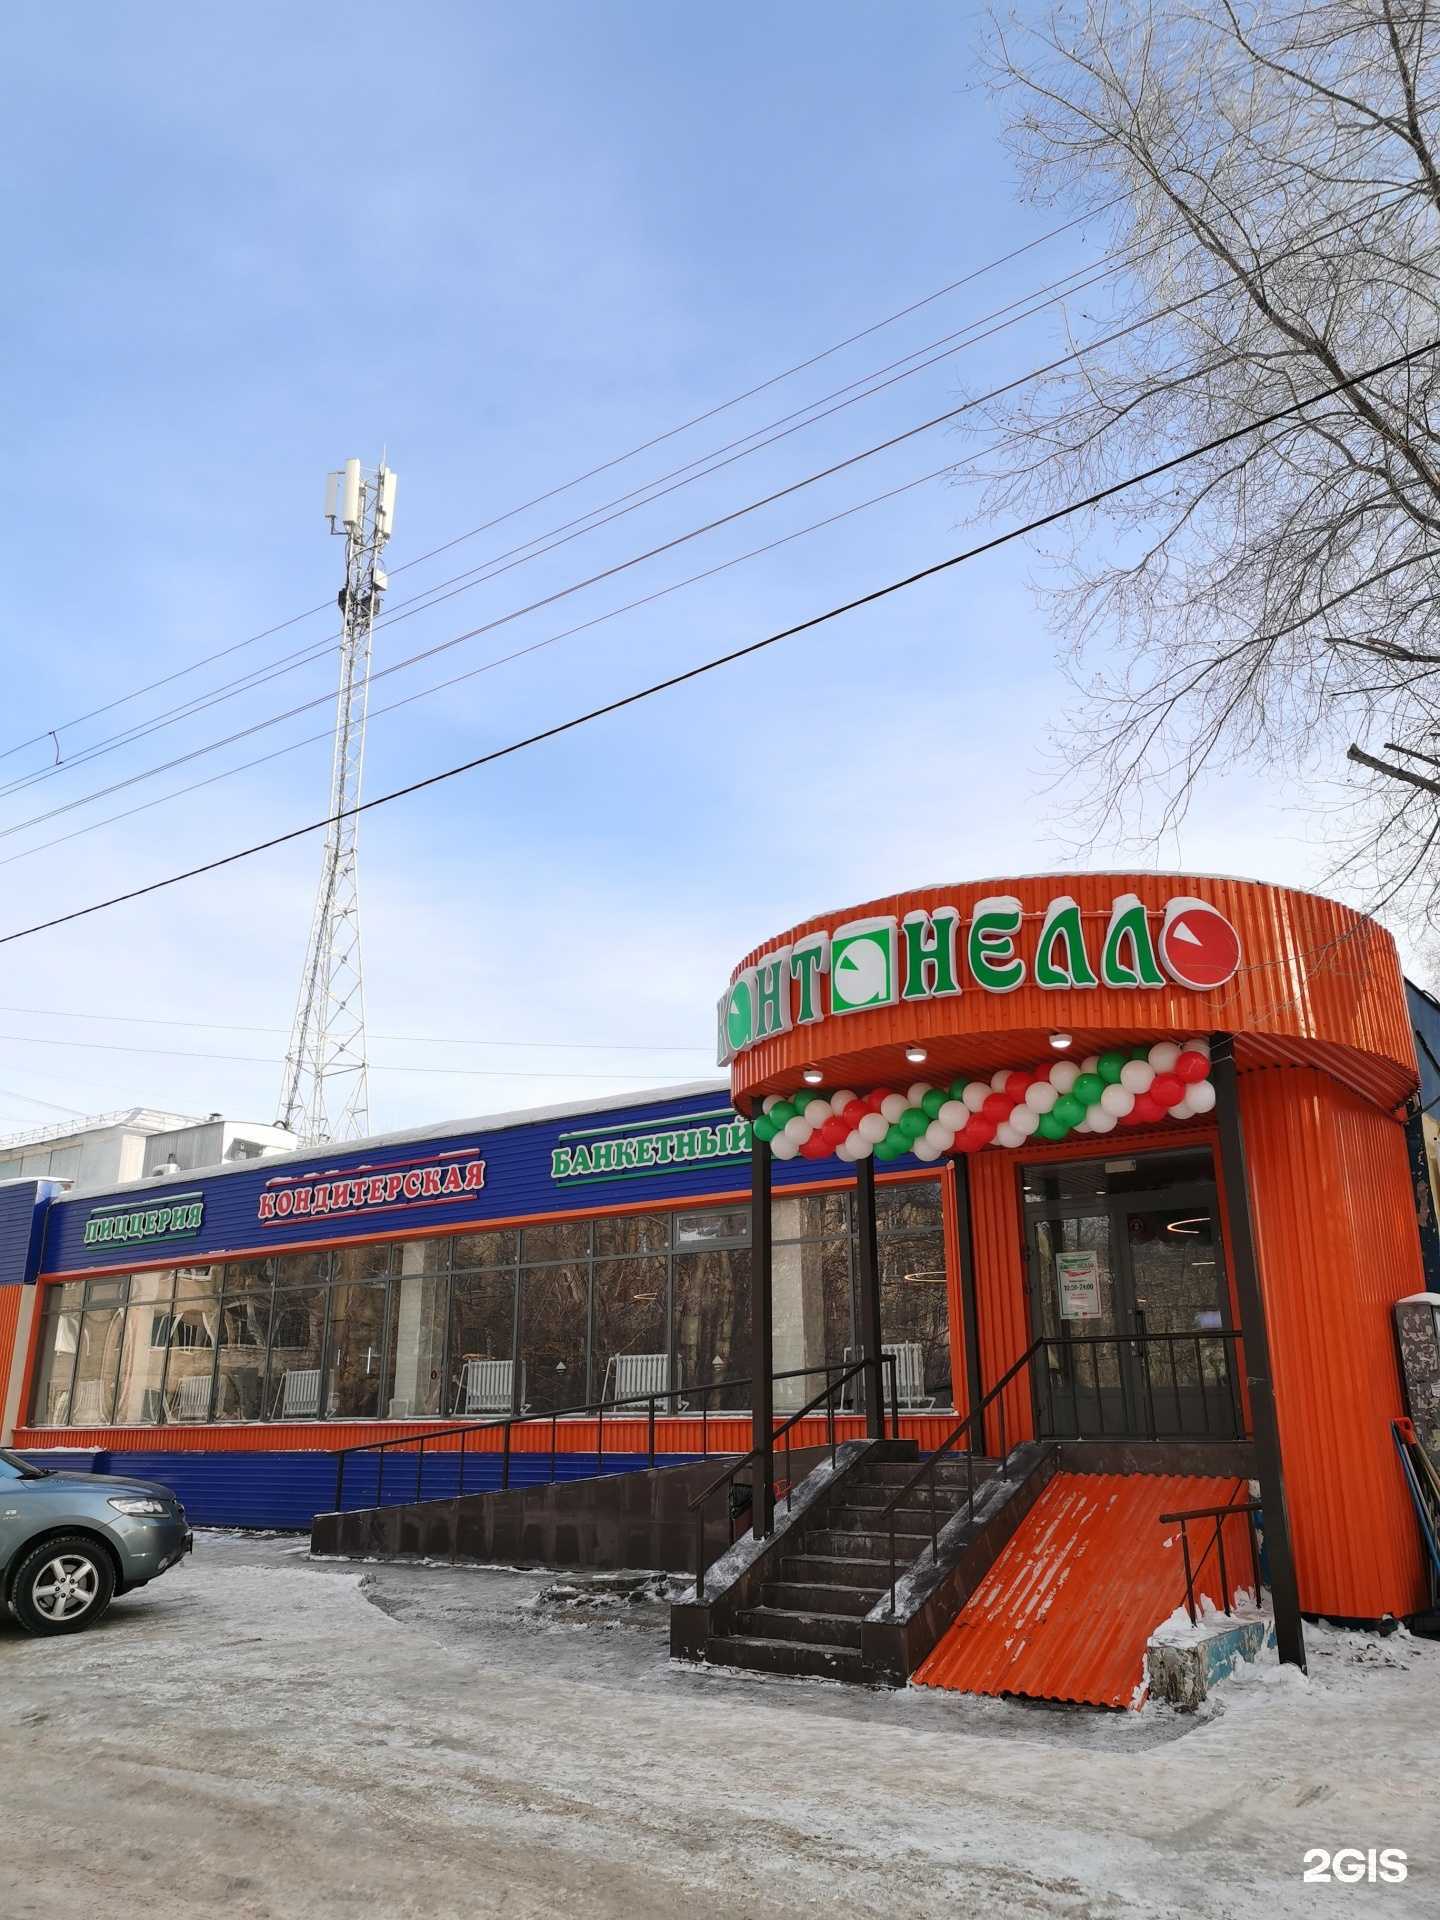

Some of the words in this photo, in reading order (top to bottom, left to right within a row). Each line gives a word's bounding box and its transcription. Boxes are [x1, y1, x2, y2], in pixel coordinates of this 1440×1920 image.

[551, 1114, 752, 1178] БАНКЕТНЫЙ
[258, 1161, 486, 1219] КОНДИТЕРСКАЯ
[84, 1203, 204, 1244] ПИЦЦЕРИЯ
